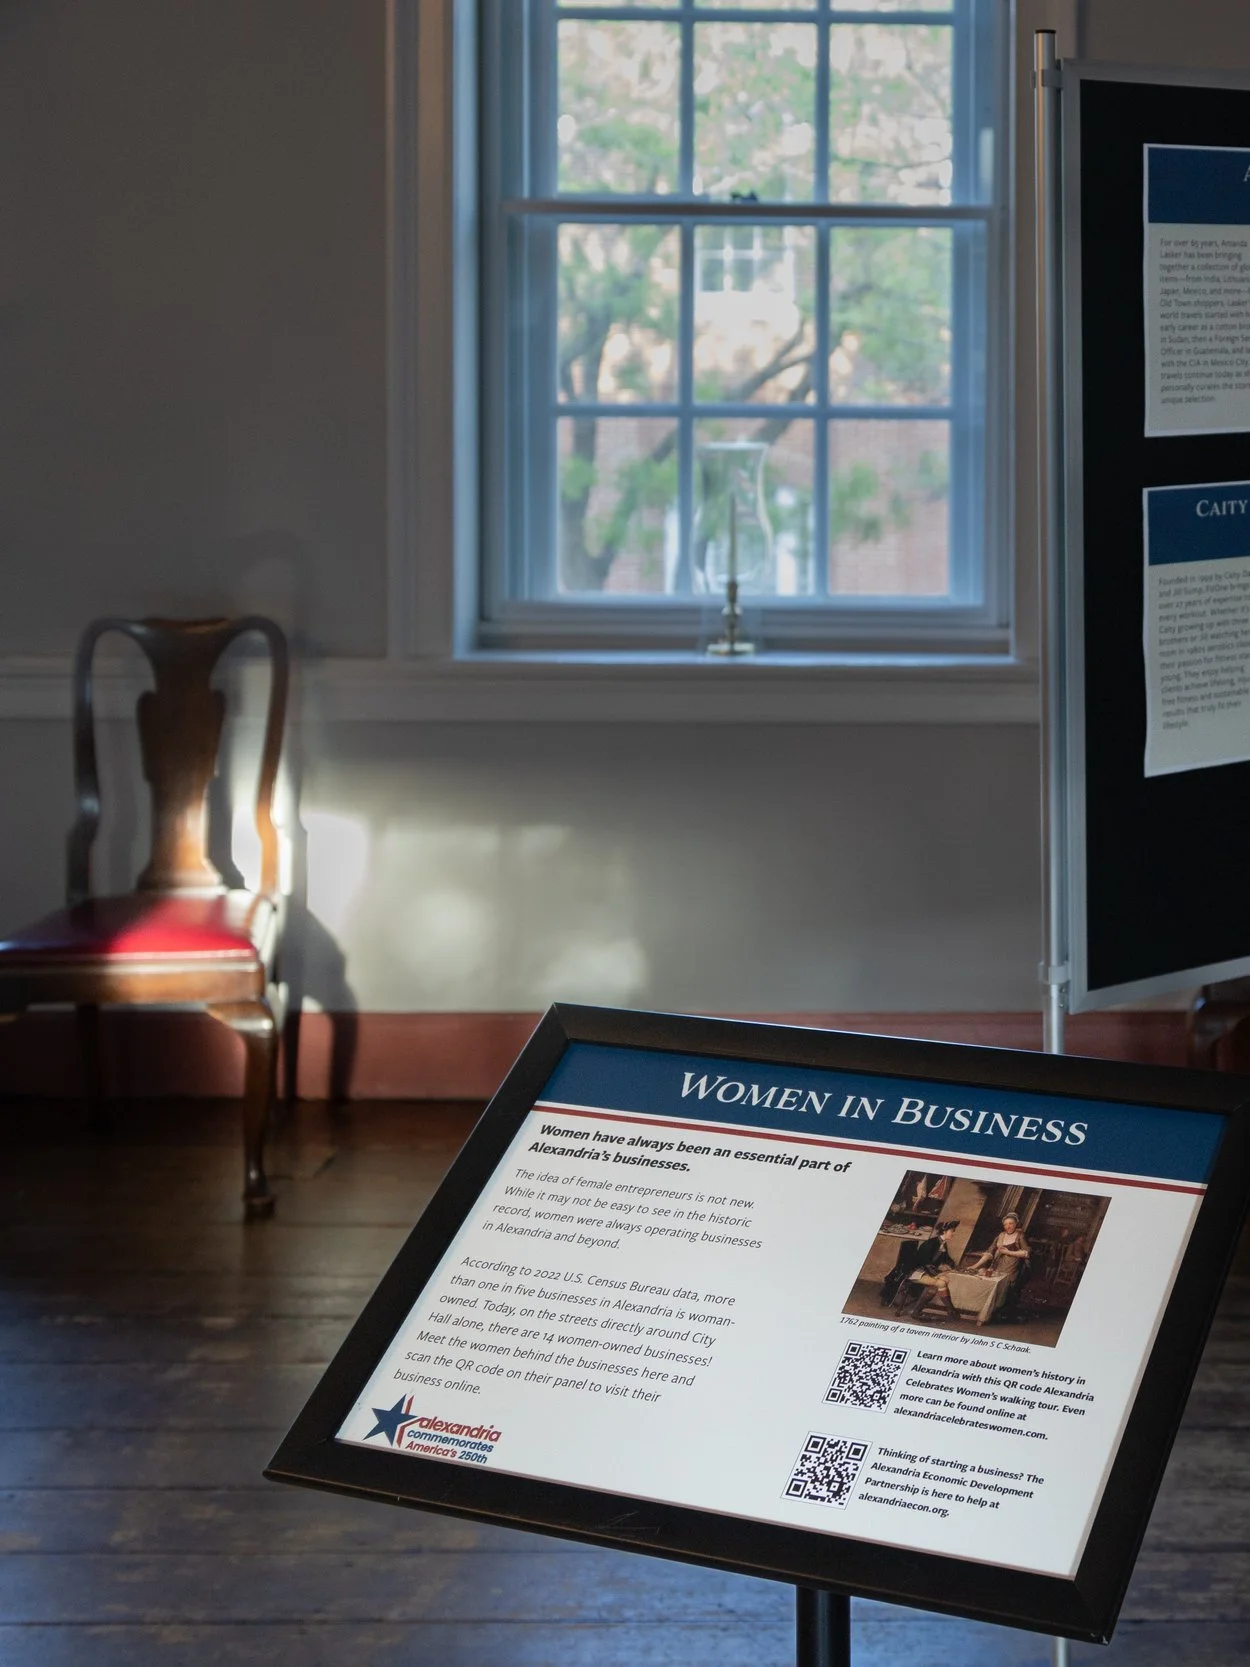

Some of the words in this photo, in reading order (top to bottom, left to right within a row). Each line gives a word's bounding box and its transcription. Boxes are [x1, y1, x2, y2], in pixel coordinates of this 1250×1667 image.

[1195, 499, 1248, 517] CAITY
[681, 1071, 833, 1115] WOMEN
[837, 1095, 885, 1121] IN
[890, 1097, 1088, 1146] BUSINESS
[540, 1124, 591, 1141] Women
[591, 1130, 626, 1145] have
[626, 1135, 675, 1153] always
[675, 1140, 712, 1155] been
[712, 1148, 732, 1158] an
[733, 1150, 800, 1166] essential
[797, 1159, 832, 1171] part
[833, 1161, 853, 1173] of
[612, 1151, 690, 1172] businesses.
[504, 1185, 535, 1199] While
[536, 1190, 546, 1201] it
[546, 1193, 572, 1206] may
[571, 1197, 592, 1207] not
[593, 1197, 609, 1209] be
[610, 1202, 636, 1215] easy
[636, 1204, 650, 1214] to
[651, 1207, 672, 1217] see
[672, 1208, 685, 1219] in
[686, 1210, 707, 1222] the
[707, 1212, 753, 1228] historic
[515, 1168, 535, 1180] The
[536, 1171, 560, 1184] idea
[561, 1175, 577, 1185] of
[575, 1176, 613, 1191] female
[614, 1184, 694, 1201] entrepreneurs
[694, 1192, 705, 1203] is
[706, 1196, 728, 1206] not
[729, 1198, 755, 1209] new.
[482, 1220, 494, 1231] in
[494, 1222, 553, 1240] Alexandria
[553, 1232, 577, 1243] and
[576, 1233, 621, 1249] beyond.
[492, 1204, 532, 1219] record,
[534, 1211, 575, 1223] women
[576, 1217, 604, 1228] were
[605, 1219, 643, 1235] always
[644, 1225, 700, 1243] operating
[700, 1230, 763, 1249] businesses
[460, 1256, 519, 1277] According
[519, 1266, 532, 1276] to
[533, 1269, 562, 1281] 2022
[563, 1271, 584, 1284] U.S.
[587, 1275, 628, 1290] Census
[629, 1280, 671, 1296] Bureau
[672, 1287, 700, 1303] data,
[703, 1294, 736, 1306] more
[450, 1274, 476, 1288] than
[477, 1281, 500, 1292] one
[500, 1282, 513, 1293] in
[514, 1283, 536, 1297] five
[536, 1287, 598, 1306] businesses
[598, 1296, 611, 1308] in
[611, 1299, 673, 1318] Alexandria
[675, 1308, 686, 1320] is
[688, 1312, 735, 1327] woman-
[427, 1311, 453, 1325] Hall
[451, 1316, 485, 1332] alone,
[487, 1321, 520, 1336] there
[520, 1329, 541, 1340] are
[542, 1332, 555, 1344] 14
[557, 1335, 644, 1355] women-owned
[643, 1345, 713, 1367] businesses!
[840, 1316, 860, 1325] 1762
[857, 1321, 890, 1332] painting
[890, 1325, 901, 1333] of
[906, 1327, 931, 1337] tavern
[930, 1332, 960, 1342] interior
[959, 1335, 971, 1345] by
[970, 1337, 989, 1347] John
[989, 1340, 996, 1348] S
[995, 1341, 1004, 1349] C
[1002, 1343, 1031, 1354] Schaak.
[393, 1368, 443, 1387] business
[443, 1379, 481, 1395] online.
[910, 1364, 960, 1379] Alexandria
[961, 1373, 983, 1383] with
[983, 1376, 1002, 1386] this
[1003, 1379, 1019, 1389] QR
[1019, 1383, 1043, 1393] code
[1043, 1386, 1095, 1402] Alexandria
[916, 1350, 943, 1361] Learn
[944, 1356, 969, 1366] more
[969, 1359, 997, 1371] about
[1040, 1370, 1076, 1385] history
[1076, 1376, 1086, 1385] in
[899, 1393, 924, 1403] more
[925, 1398, 942, 1406] can
[943, 1399, 956, 1409] be
[956, 1401, 986, 1414] found
[986, 1408, 1016, 1419] online
[1016, 1413, 1028, 1421] at
[905, 1378, 955, 1393] Celebrates
[999, 1395, 1037, 1410] walking
[1037, 1401, 1059, 1412] tour.
[1061, 1404, 1086, 1416] Even
[406, 1428, 495, 1453] commemorates
[418, 1416, 503, 1443] alexandria
[893, 1406, 1048, 1440] alexandriacelebrateswomen.com.
[457, 1450, 488, 1464] 250th
[878, 1447, 918, 1464] Thinking
[918, 1455, 931, 1464] of
[930, 1458, 969, 1473] starting
[977, 1464, 1025, 1481] business?
[1026, 1473, 1045, 1485] The
[864, 1477, 920, 1496] Partnership
[920, 1486, 930, 1496] is
[931, 1488, 953, 1501] here
[954, 1494, 965, 1503] to
[966, 1495, 988, 1509] help
[988, 1501, 1000, 1509] at
[870, 1462, 921, 1478] Alexandria
[922, 1471, 969, 1487] Economic
[969, 1479, 1034, 1499] Development
[858, 1492, 950, 1518] alexandriaecon.org.
